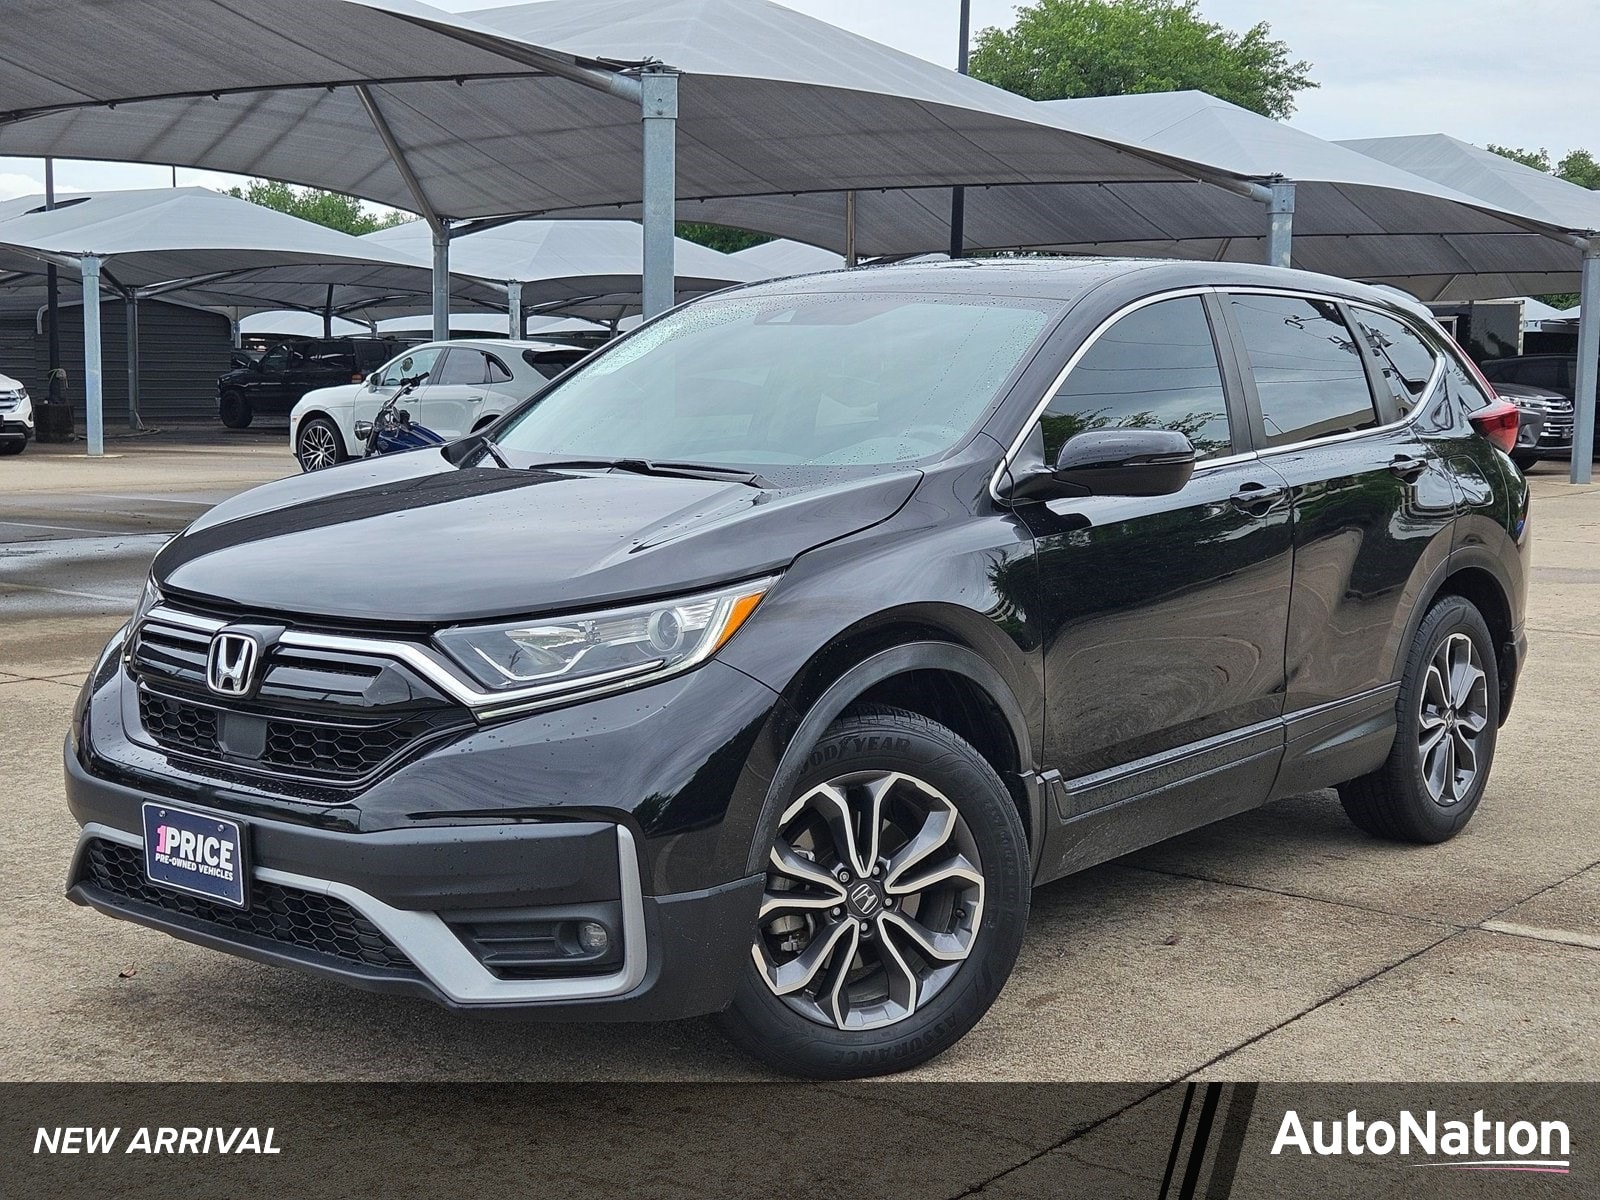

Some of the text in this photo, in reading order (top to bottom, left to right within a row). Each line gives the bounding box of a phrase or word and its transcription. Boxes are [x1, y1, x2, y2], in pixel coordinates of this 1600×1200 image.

[155, 853, 234, 881] PRE-OWNED VEHICLES
[156, 825, 234, 871] 1PRICE
[833, 1012, 957, 1066] ASSURANCE
